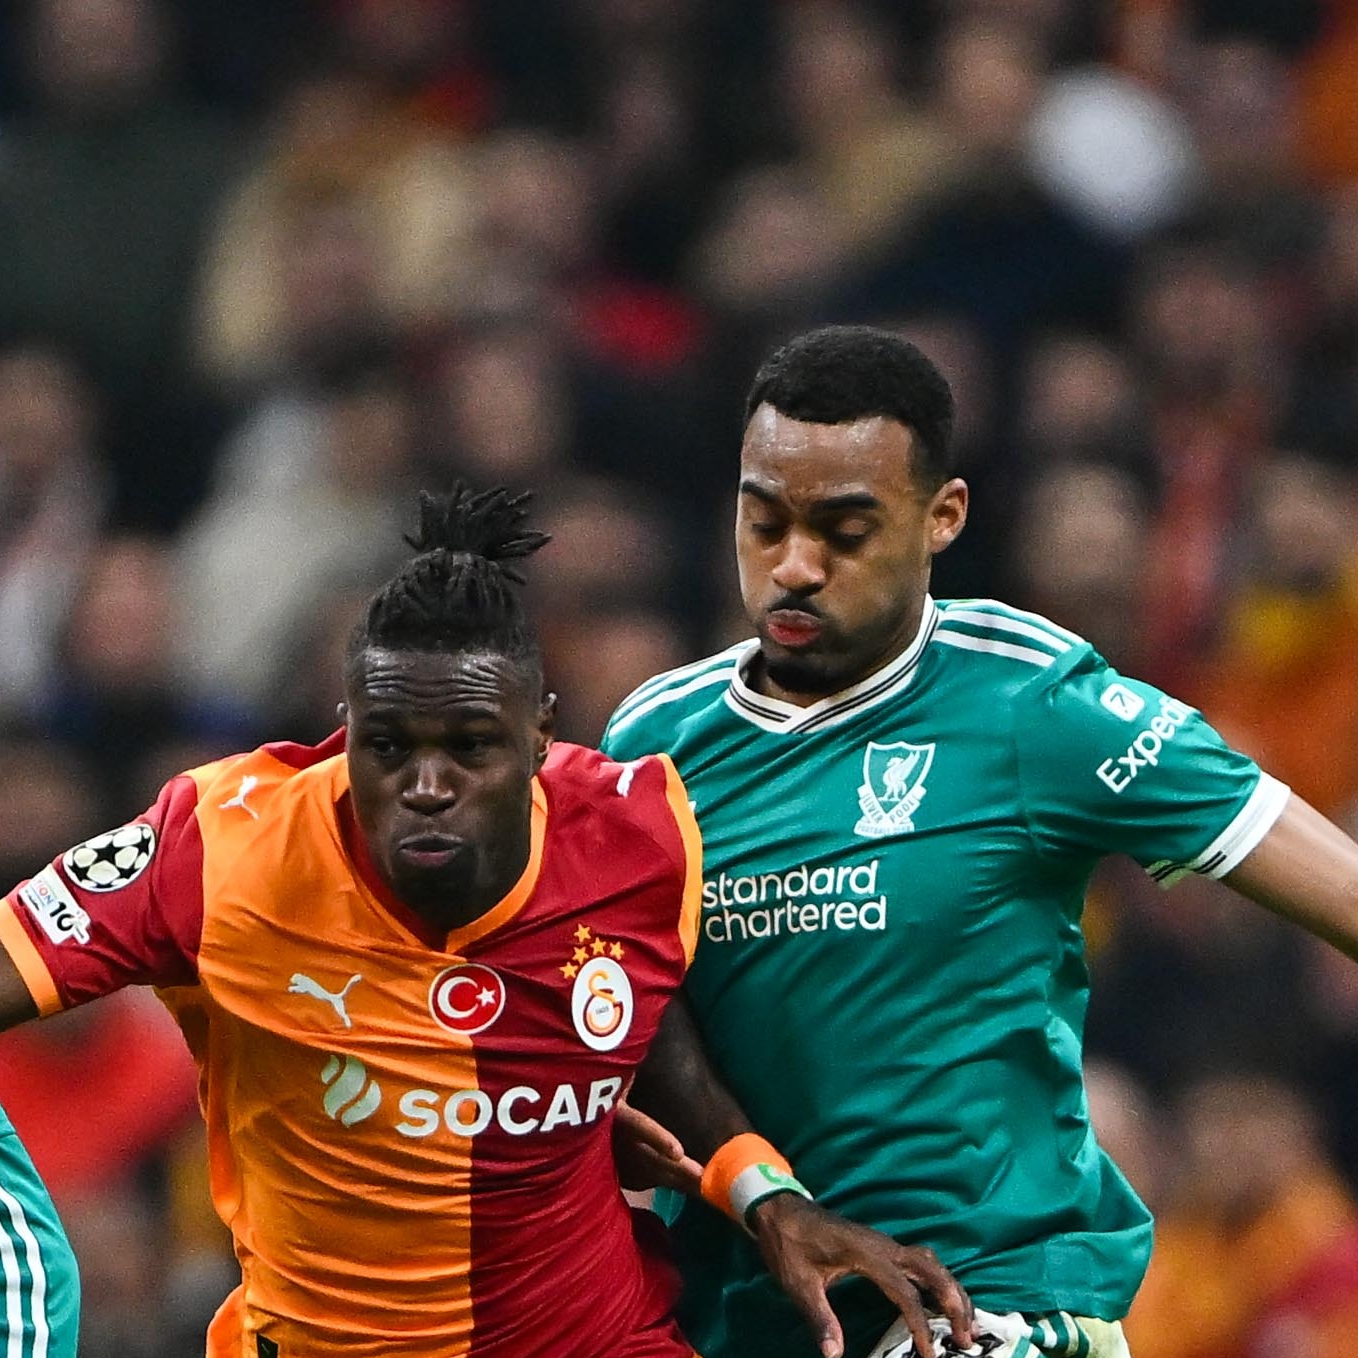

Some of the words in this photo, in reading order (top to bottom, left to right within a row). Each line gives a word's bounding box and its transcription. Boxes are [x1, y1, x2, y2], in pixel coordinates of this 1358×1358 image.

[702, 860, 879, 908] standard
[705, 895, 888, 943] chartered
[395, 1077, 622, 1137] SOCAR
